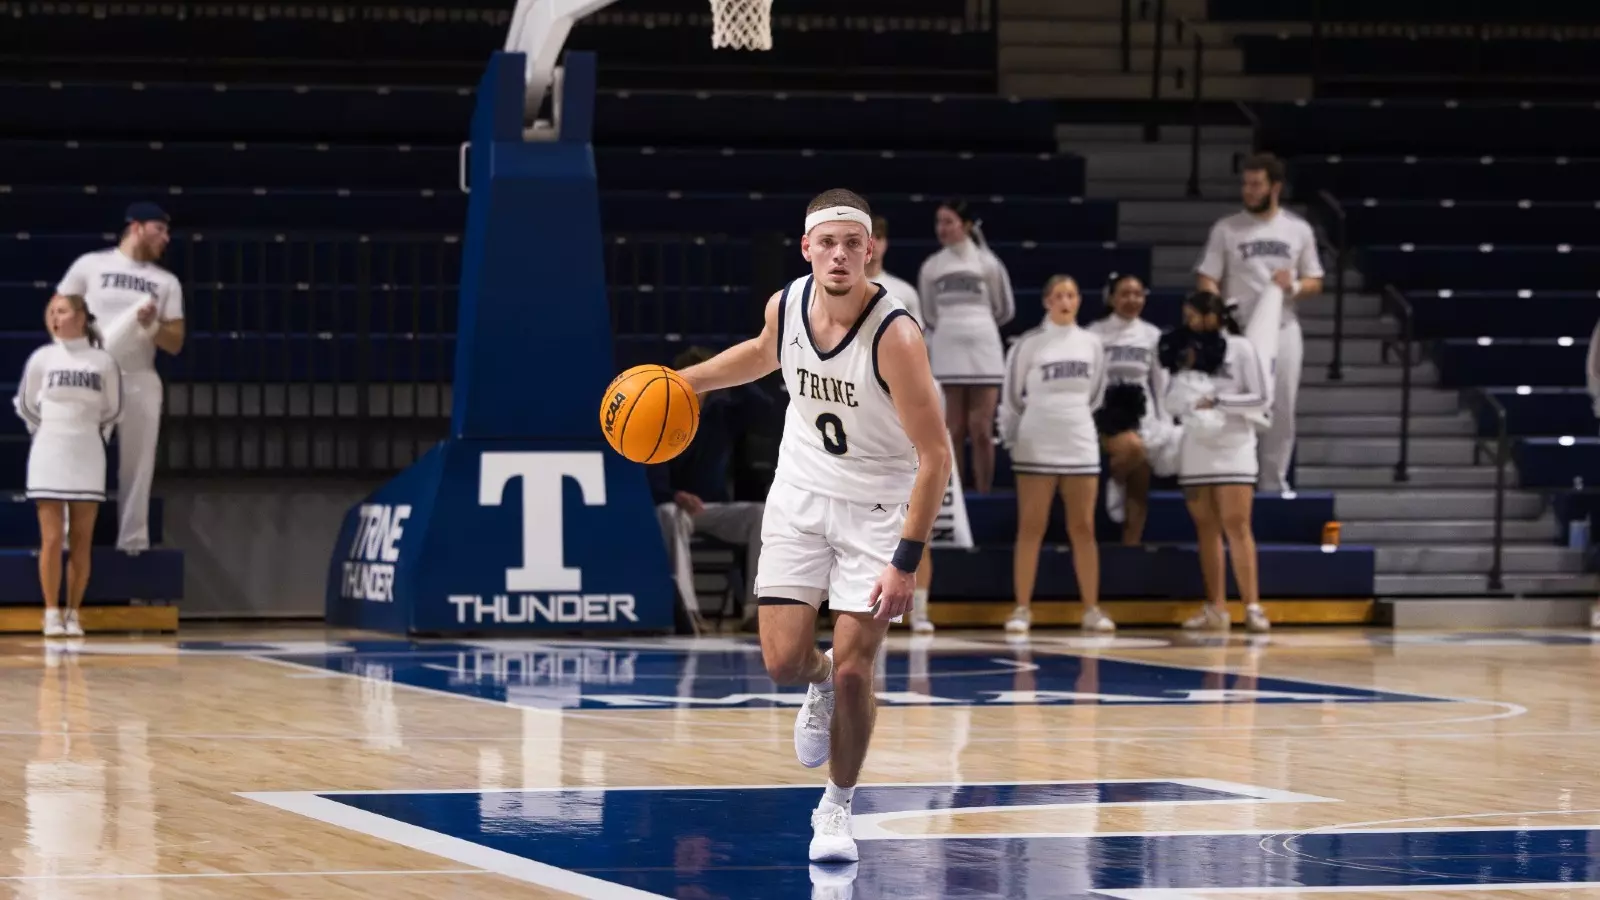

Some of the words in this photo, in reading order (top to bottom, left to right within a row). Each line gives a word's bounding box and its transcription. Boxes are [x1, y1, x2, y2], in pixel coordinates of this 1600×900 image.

[48, 370, 102, 392] TRINE
[797, 367, 859, 408] TRINE
[605, 392, 627, 439] NCAA
[815, 412, 848, 456] 0
[478, 451, 607, 592] T
[448, 594, 639, 623] THUNDER
